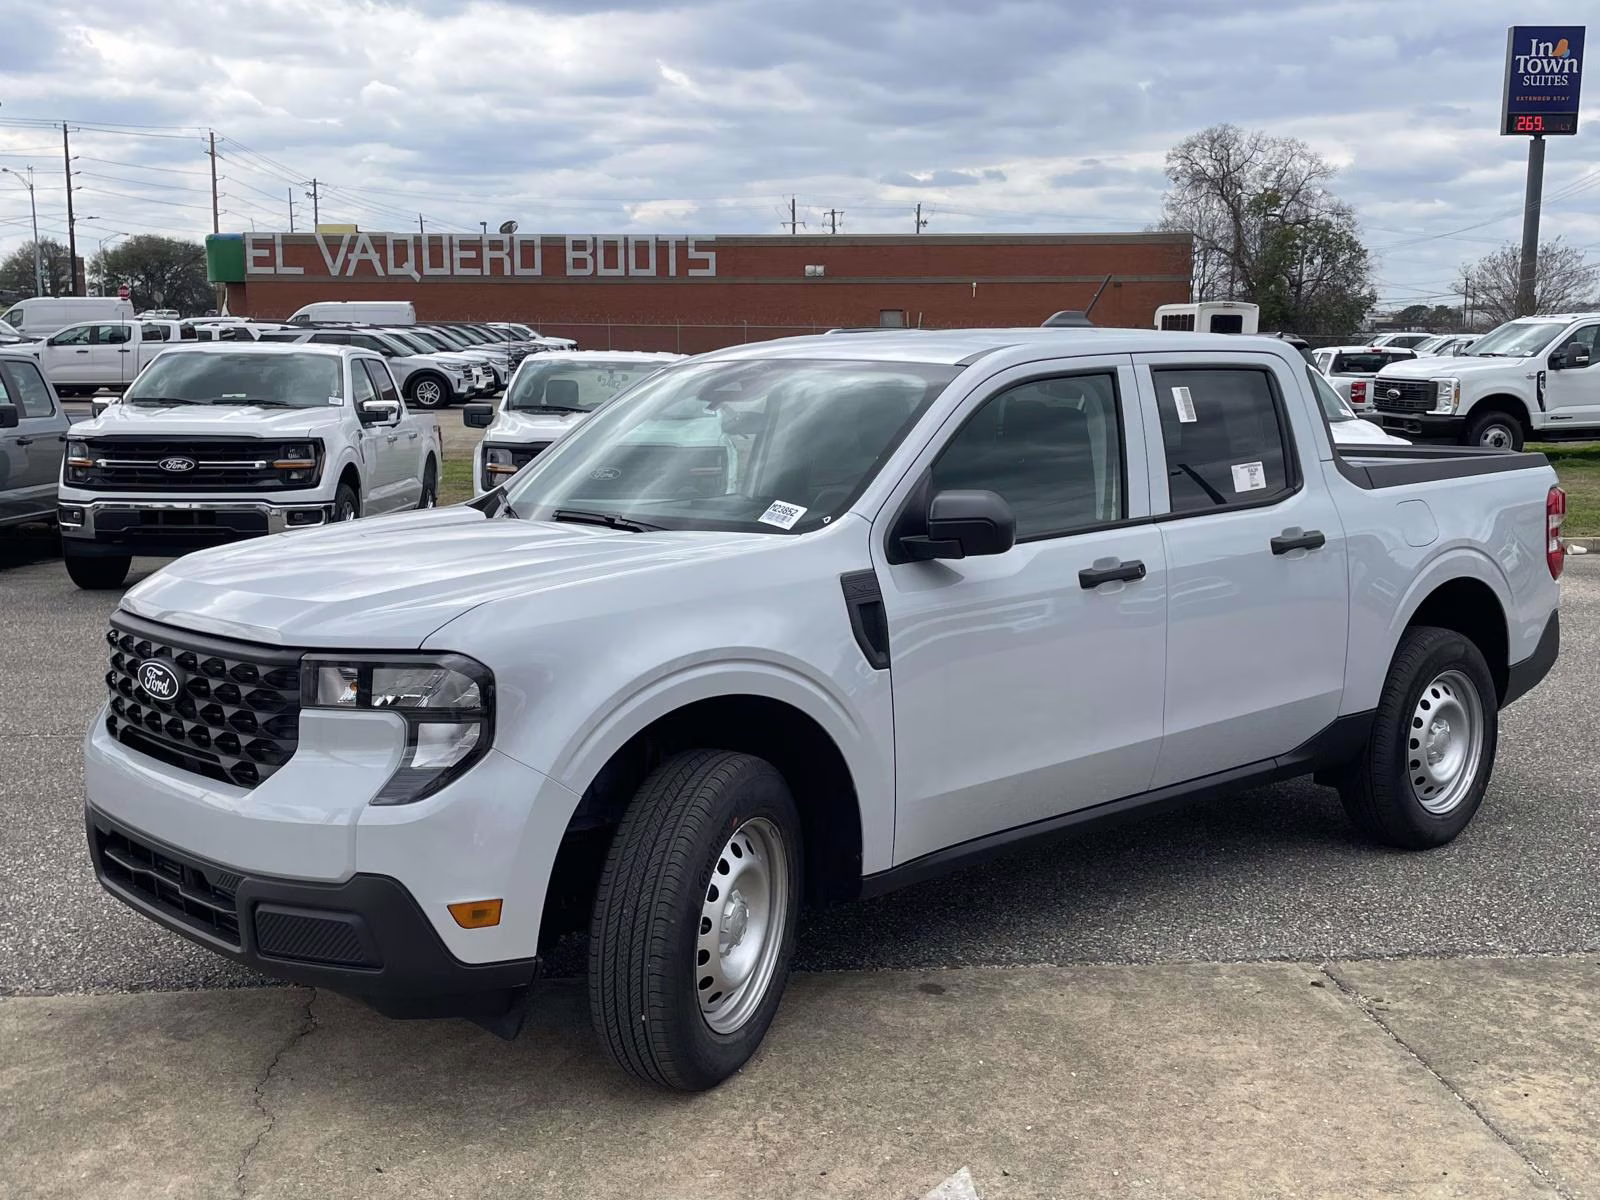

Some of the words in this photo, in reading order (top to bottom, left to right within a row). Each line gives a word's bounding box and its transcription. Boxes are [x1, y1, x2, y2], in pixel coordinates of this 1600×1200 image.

[1530, 38, 1553, 57] In
[1515, 55, 1578, 74] Town
[1522, 74, 1569, 86] SUITES
[245, 233, 305, 275] EL
[314, 232, 543, 283] VAQUERO
[566, 234, 717, 278] BOOTS
[144, 665, 171, 696] Ford
